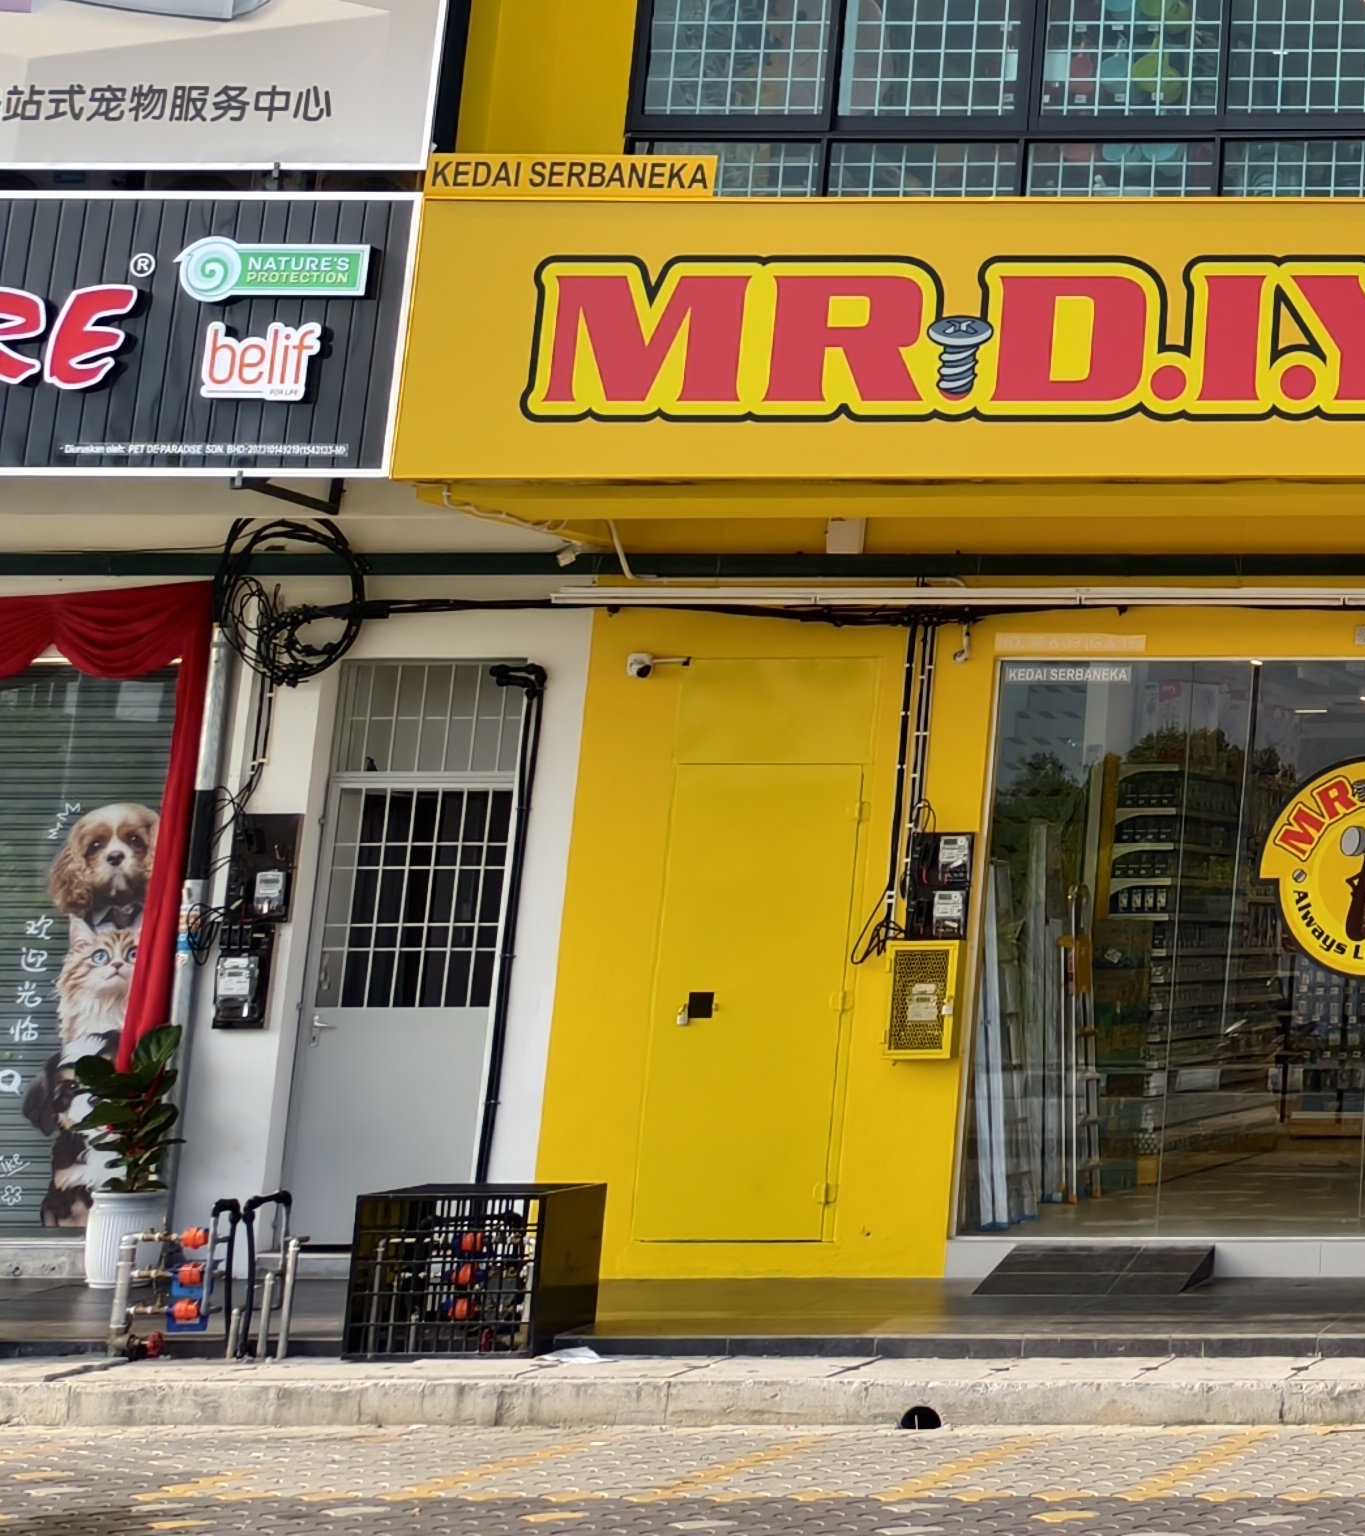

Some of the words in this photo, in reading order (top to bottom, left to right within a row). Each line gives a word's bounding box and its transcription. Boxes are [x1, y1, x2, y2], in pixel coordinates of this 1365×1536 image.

[0, 84, 333, 124] 站式宠物服务中心
[430, 161, 522, 188] KEDAI
[528, 162, 709, 190] SERBANEKA
[246, 270, 349, 284] PROTECTION
[247, 256, 350, 272] NATURE'S
[207, 328, 316, 386] belif
[1008, 668, 1047, 681] KEDAI
[1050, 668, 1128, 681] SERBANEKA
[1293, 889, 1348, 955] Always
[10, 914, 54, 1043] 欢迎光临
